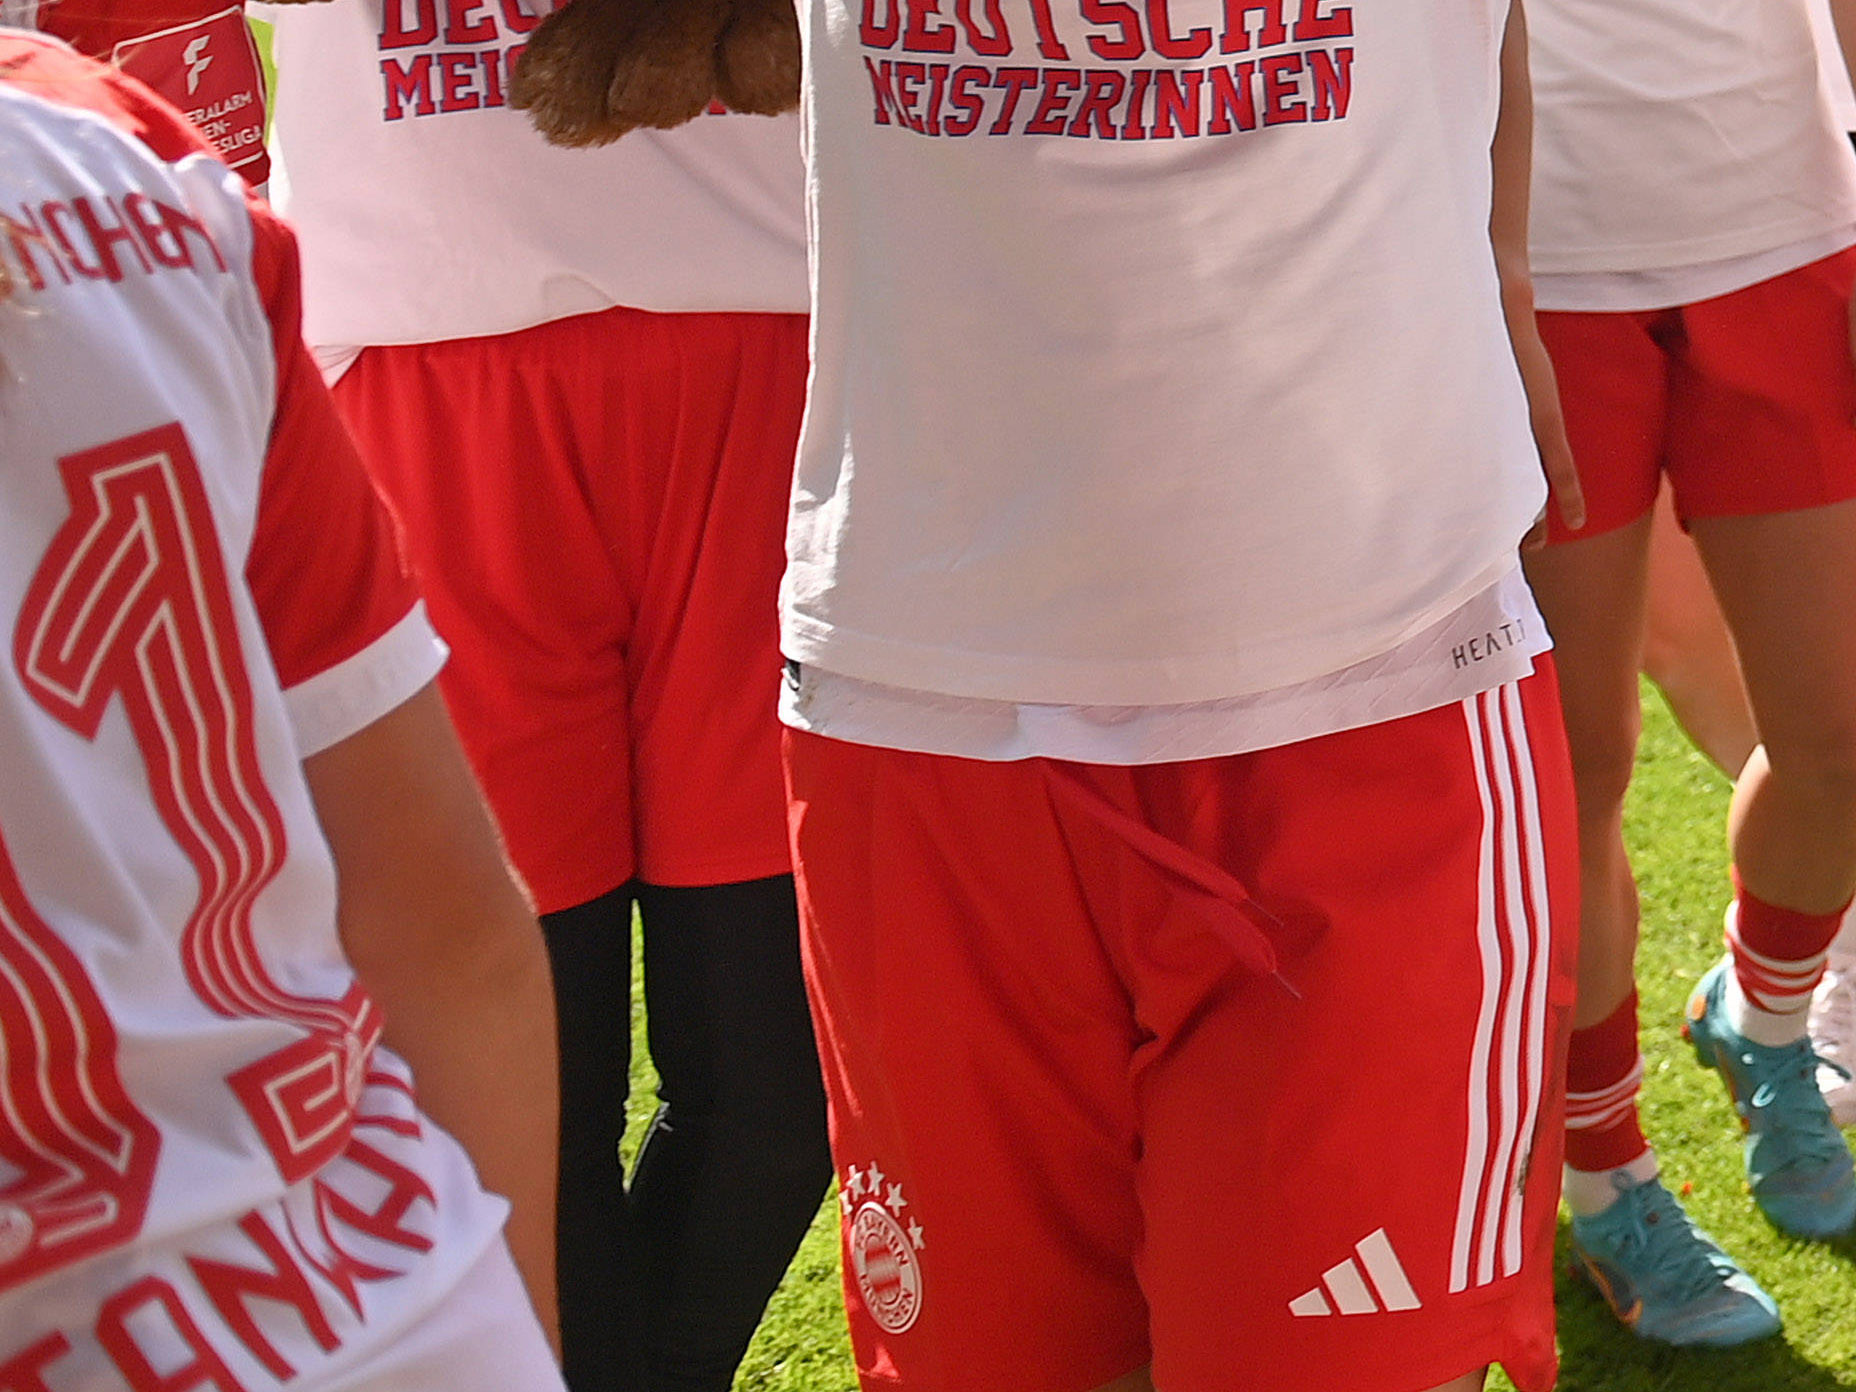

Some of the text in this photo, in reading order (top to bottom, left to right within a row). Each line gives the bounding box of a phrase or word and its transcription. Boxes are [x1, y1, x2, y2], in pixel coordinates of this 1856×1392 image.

[182, 92, 253, 125] ERALARM
[864, 48, 1354, 140] MEISTERINNEN
[2, 194, 227, 291] NCHEN
